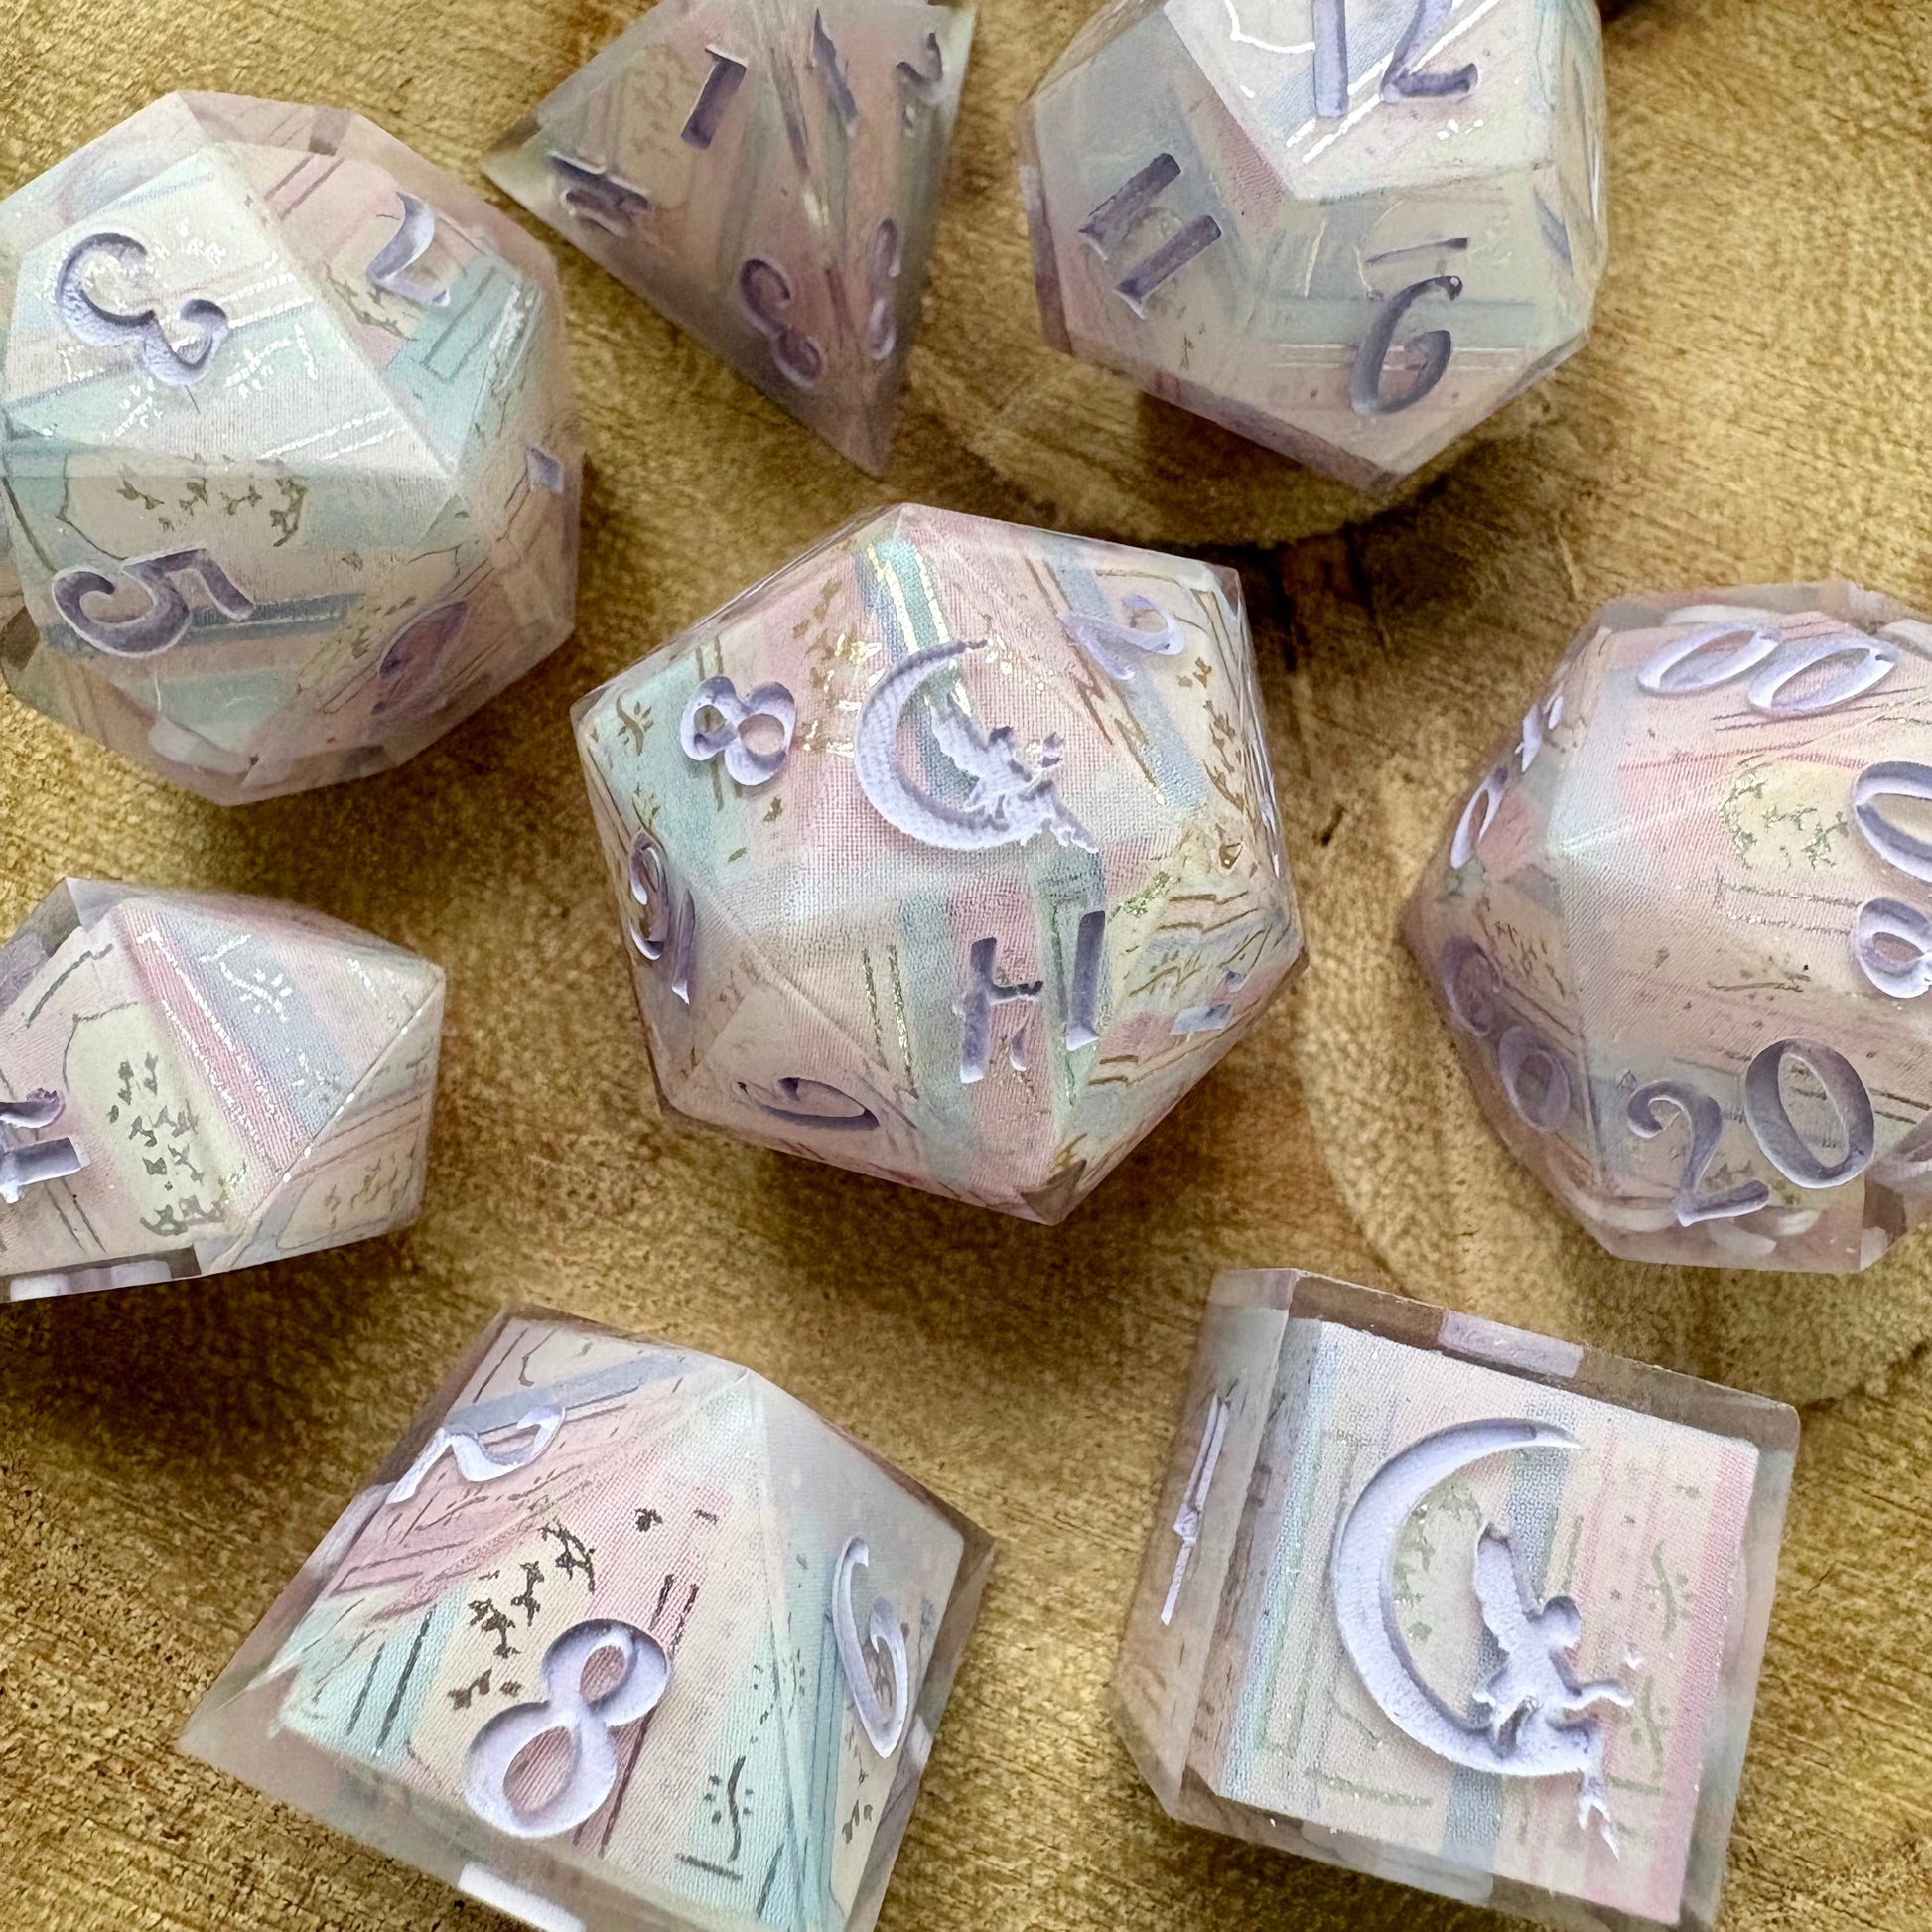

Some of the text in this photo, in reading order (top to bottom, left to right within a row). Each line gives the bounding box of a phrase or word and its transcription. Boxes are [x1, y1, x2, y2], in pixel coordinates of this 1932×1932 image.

[57, 231, 229, 387] 3
[51, 548, 255, 658] 5
[1637, 622, 1899, 715] 00
[680, 676, 797, 786] 8
[1625, 1037, 1876, 1227] 20
[463, 1618, 671, 1839] 8
